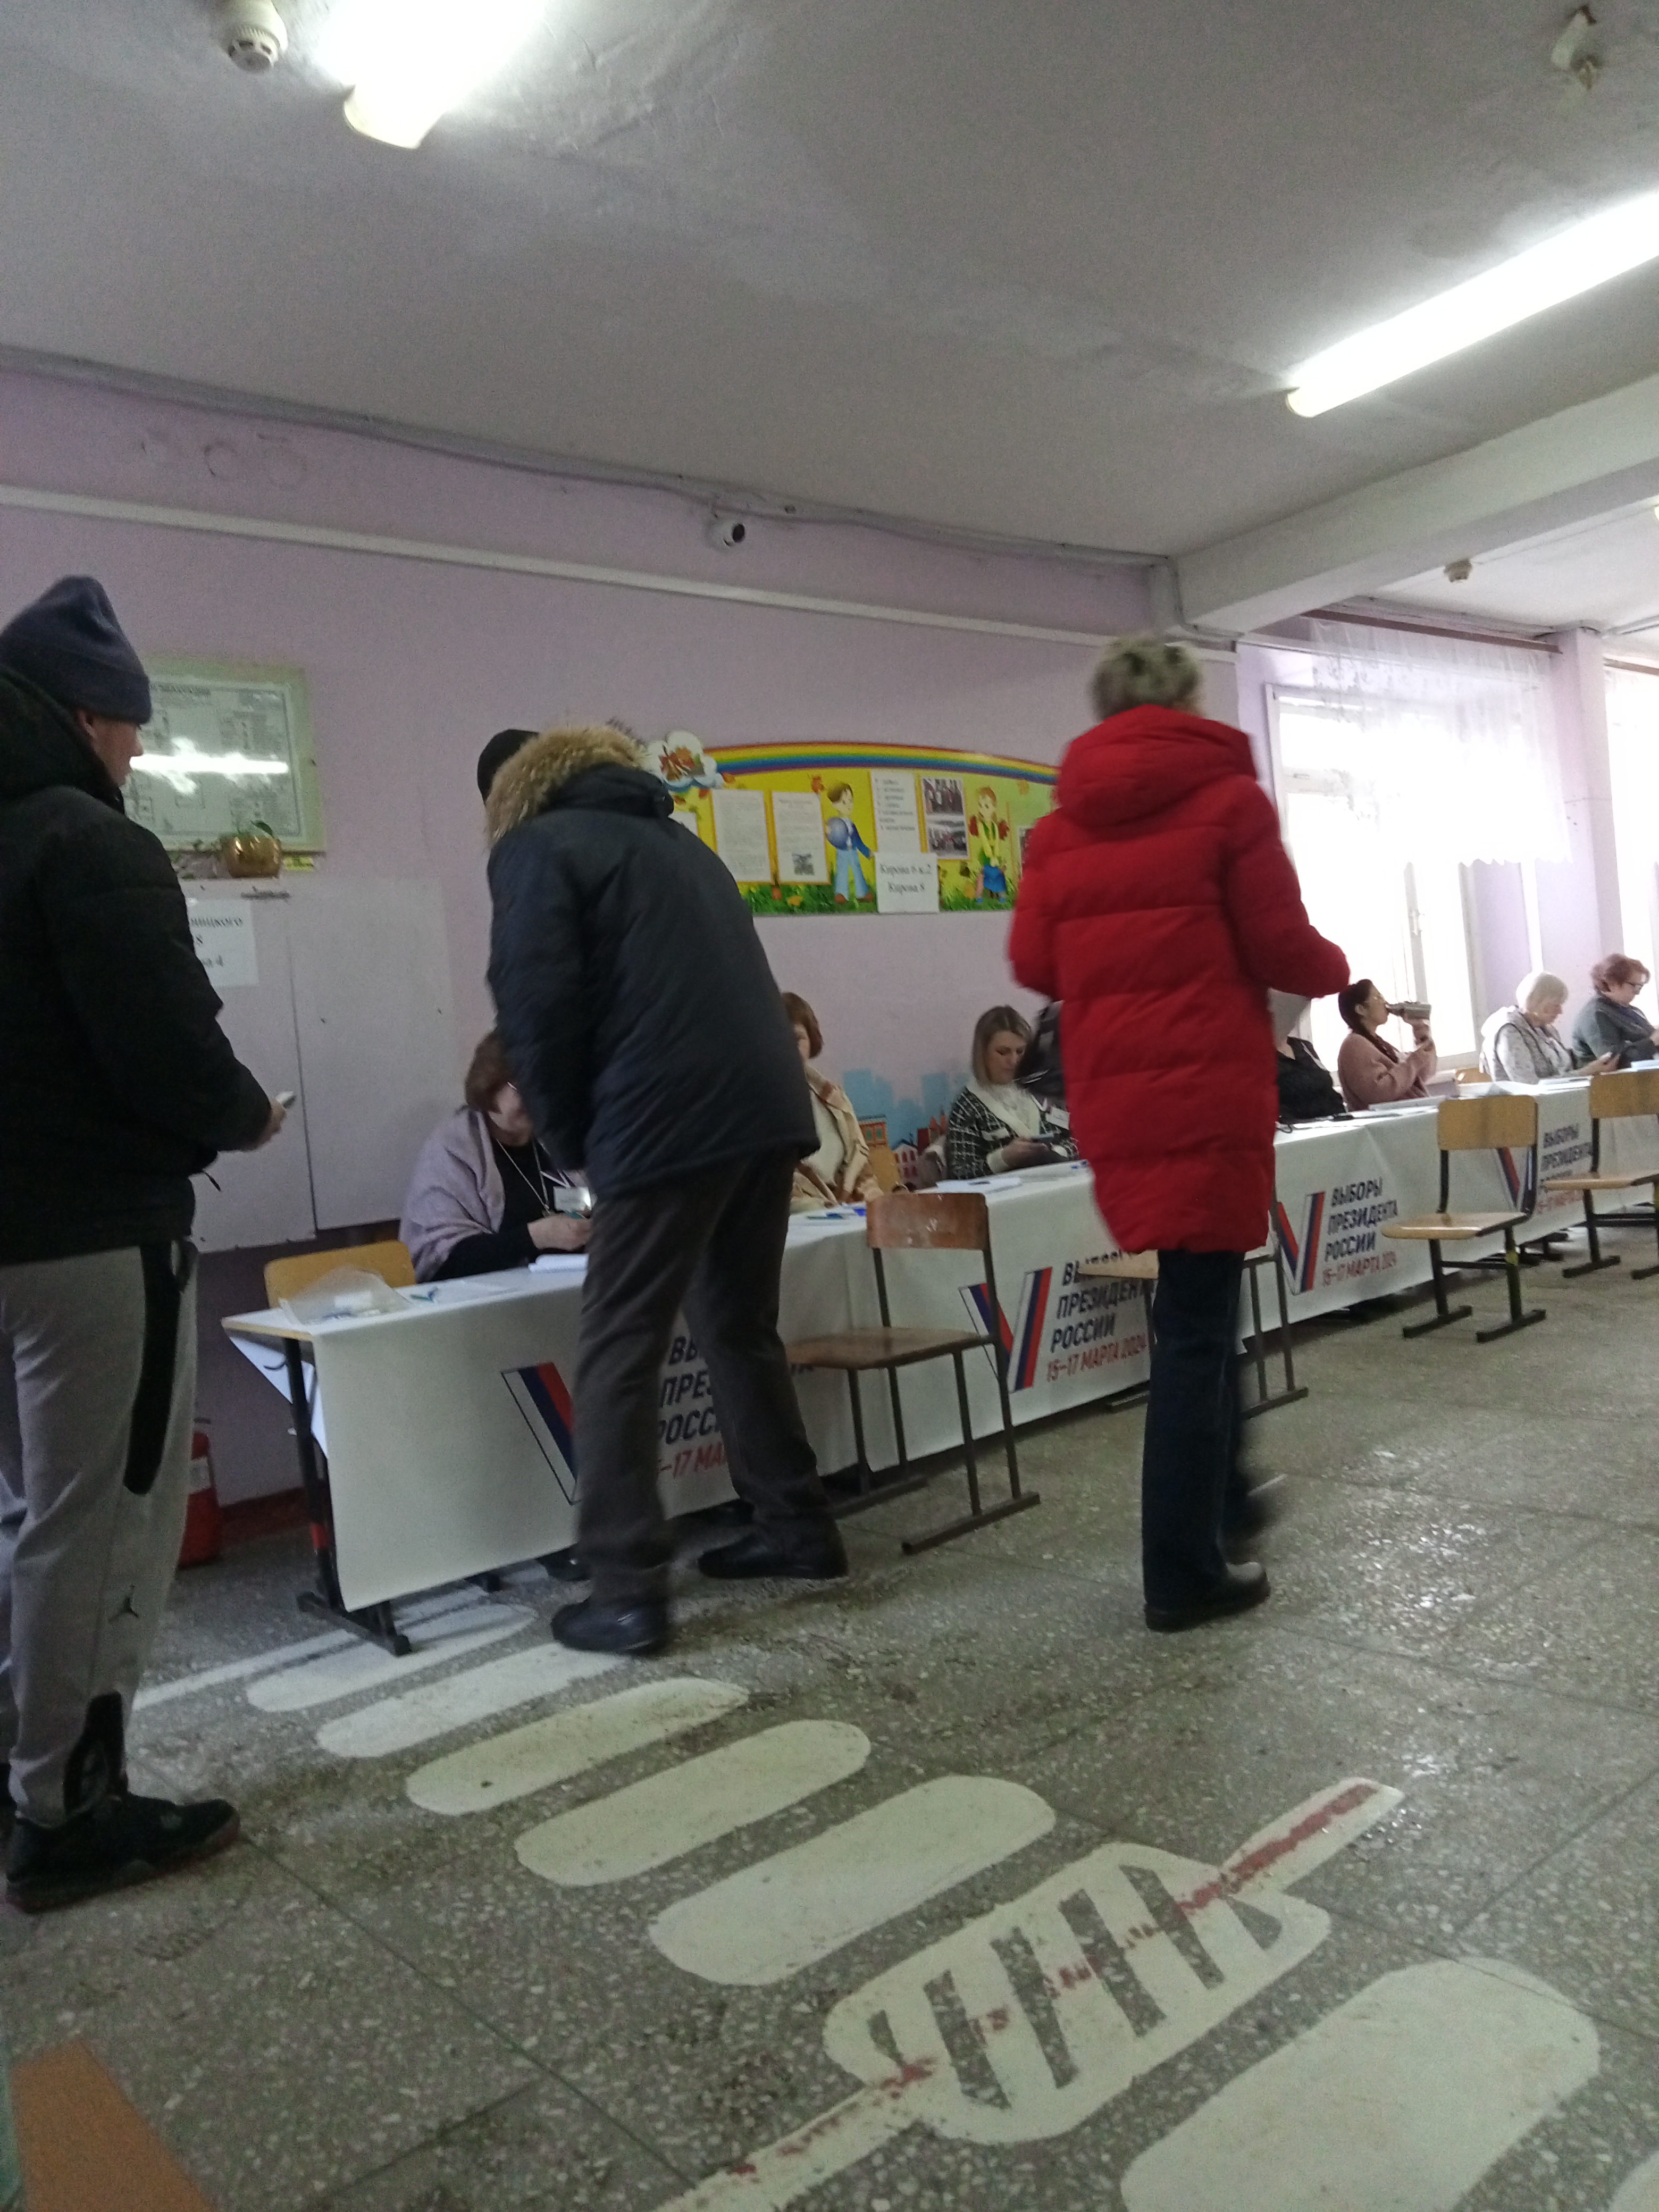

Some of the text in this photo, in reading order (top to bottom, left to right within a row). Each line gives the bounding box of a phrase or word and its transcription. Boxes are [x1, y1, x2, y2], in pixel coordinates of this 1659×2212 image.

[1331, 1176, 1382, 1208] ВЫБОРЫ
[1327, 1199, 1398, 1235] ПРЕЗИДЕНТА
[1325, 1231, 1376, 1262] РОССИИ
[1050, 1312, 1115, 1354] РОССИИ
[1046, 1353, 1080, 1382] 15-17
[1080, 1342, 1119, 1372] МАРТА
